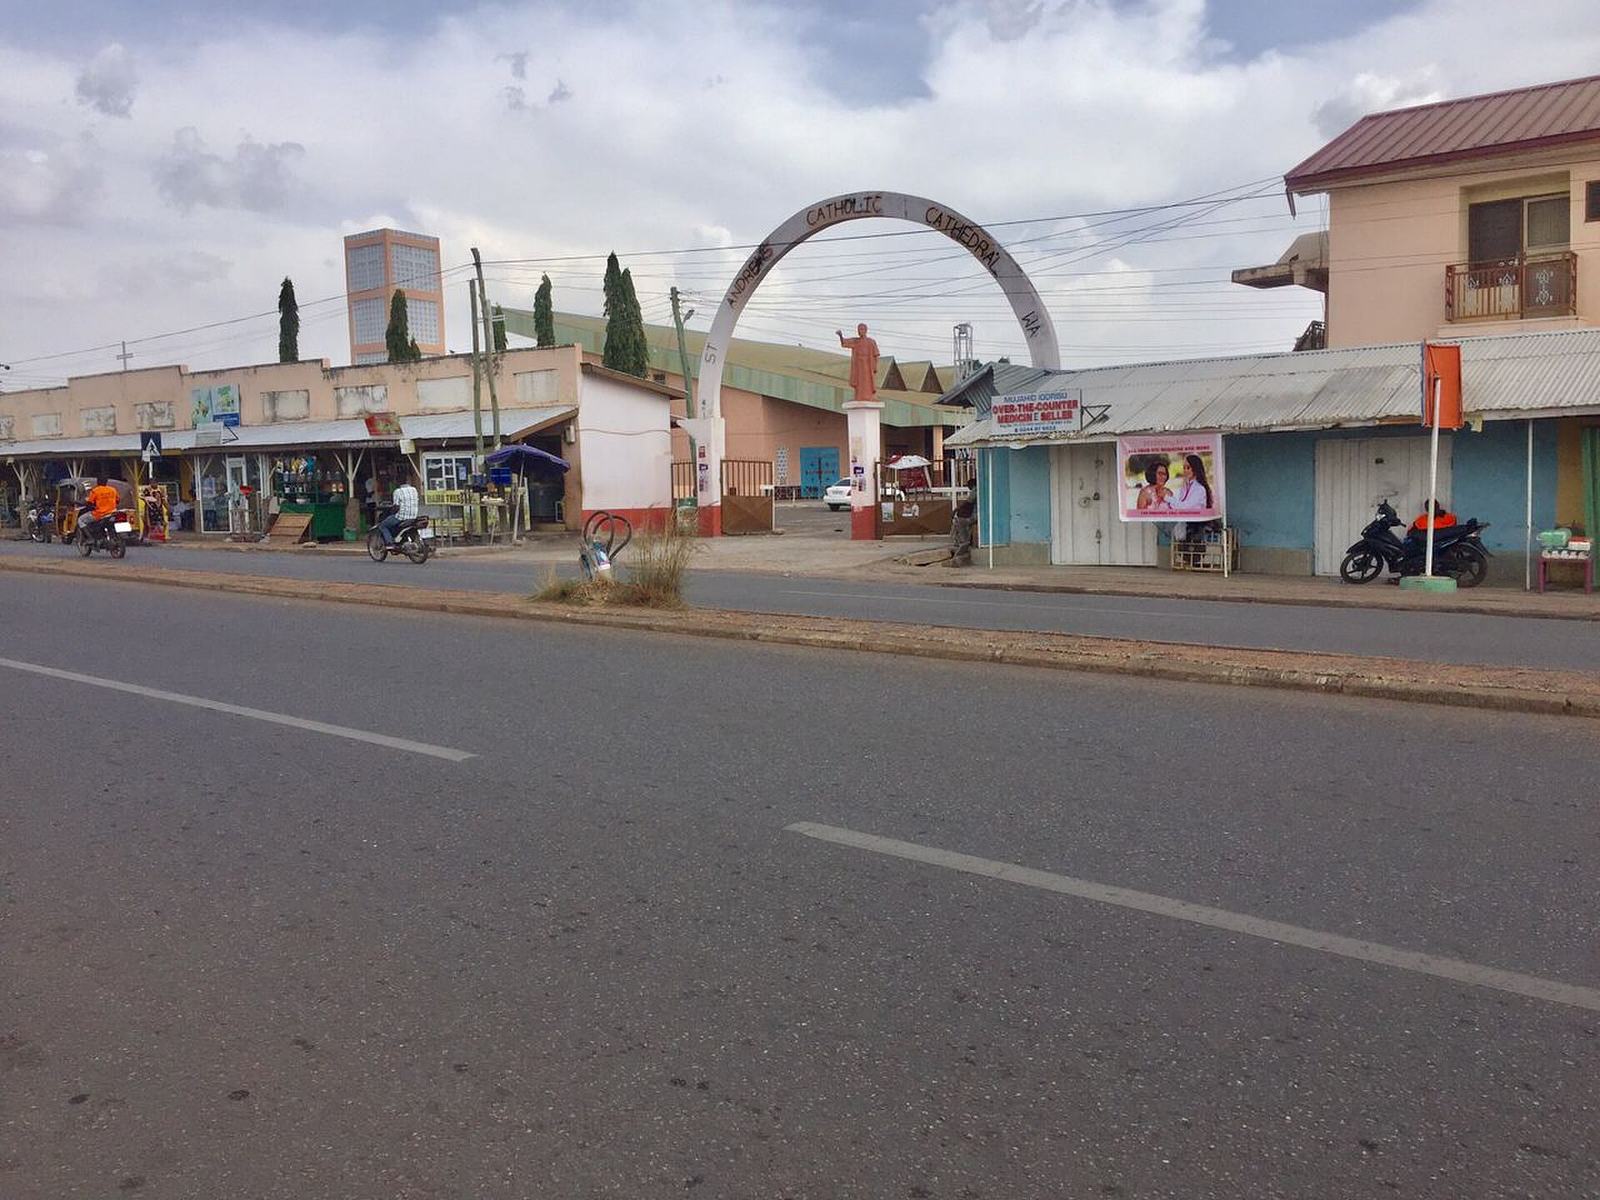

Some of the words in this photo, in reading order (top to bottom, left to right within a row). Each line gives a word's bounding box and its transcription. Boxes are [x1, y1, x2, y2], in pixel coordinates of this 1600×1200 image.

[704, 343, 718, 363] ST
[806, 195, 883, 226] CATHOLIC
[925, 207, 1002, 277] CATHEDRAL
[1021, 310, 1041, 338] WA
[992, 400, 1079, 414] OVER-THE-COUNTER
[997, 411, 1039, 424] MEDICINE
[1040, 410, 1073, 421] SELLER
